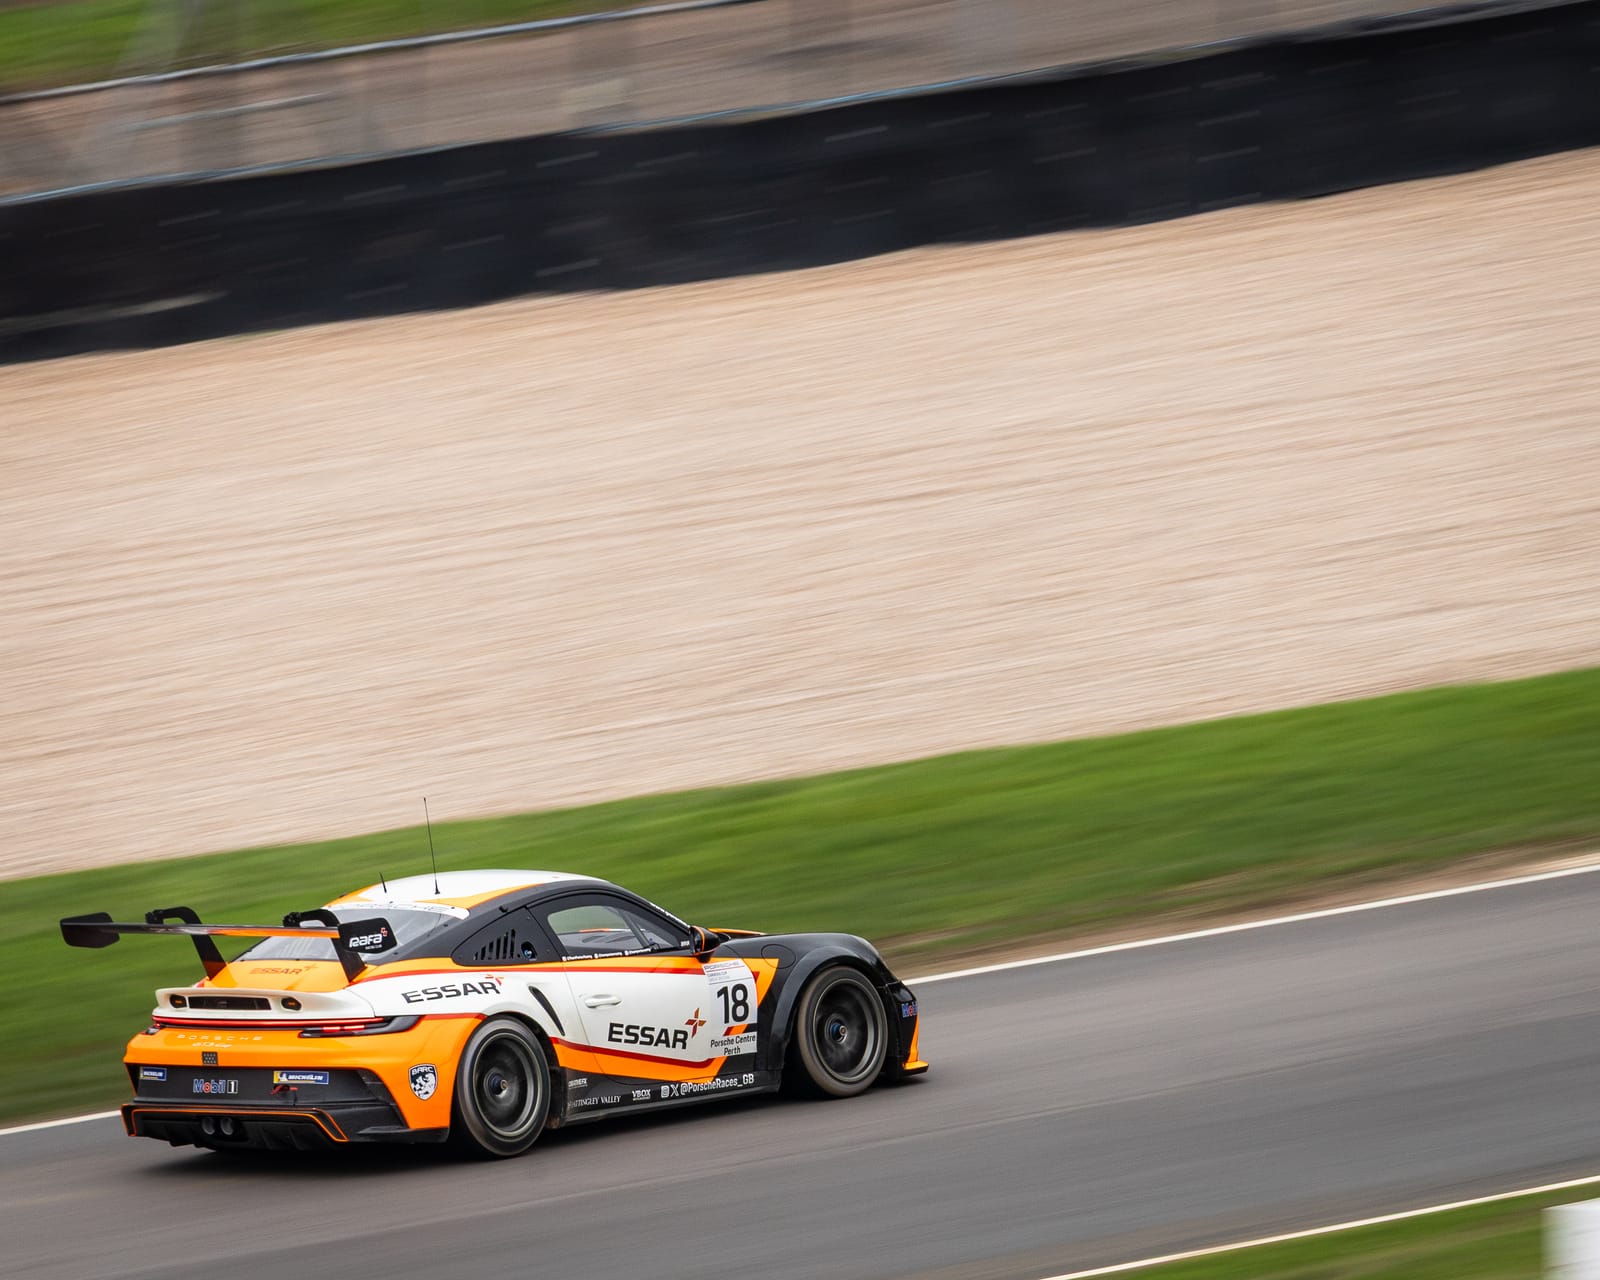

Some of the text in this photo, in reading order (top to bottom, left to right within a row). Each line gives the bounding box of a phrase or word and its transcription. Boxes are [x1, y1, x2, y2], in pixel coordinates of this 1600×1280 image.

[249, 967, 303, 975] ESSAR
[401, 981, 501, 1004] ESSAR
[716, 983, 750, 1025] 18
[608, 1022, 689, 1050] ESSAR
[710, 1034, 756, 1048] Porsche Centre
[723, 1046, 741, 1056] Perth
[411, 1066, 434, 1076] BARC
[193, 1079, 226, 1094] Mobil
[680, 1073, 755, 1096] @PorscheRaces_GB
[600, 1095, 622, 1105] VALLEY
[631, 1089, 651, 1098] VBOX
